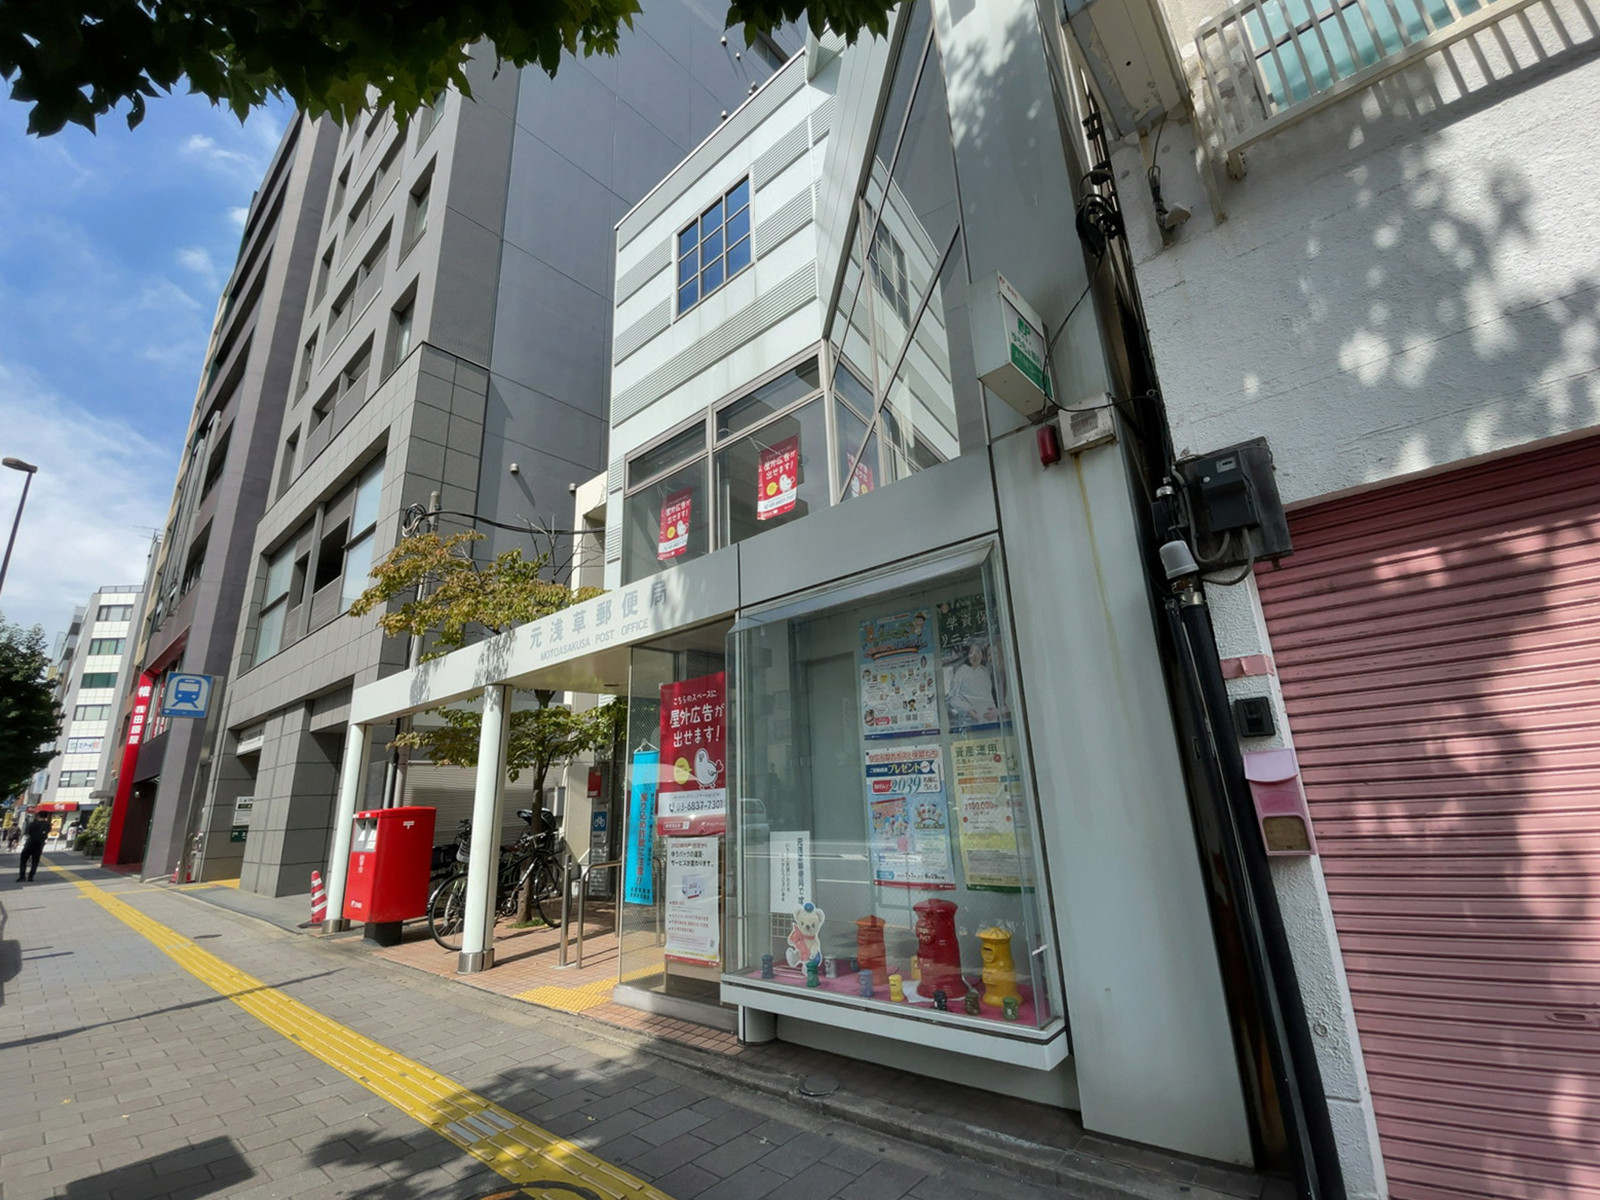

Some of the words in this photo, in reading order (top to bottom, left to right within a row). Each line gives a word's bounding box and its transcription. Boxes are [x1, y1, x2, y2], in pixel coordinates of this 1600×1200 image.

[529, 581, 667, 649] 元浅草郵便局
[540, 640, 591, 662] MOTOASAKUSA
[595, 629, 614, 643] POST
[621, 618, 649, 636] OFFICE
[673, 689, 717, 706] こちらのスペースに
[670, 702, 724, 728] 屋外広告が
[673, 726, 721, 748] 出せます!
[955, 743, 998, 758] 資産運用
[888, 763, 921, 774] プレゼント
[891, 776, 921, 795] 2039
